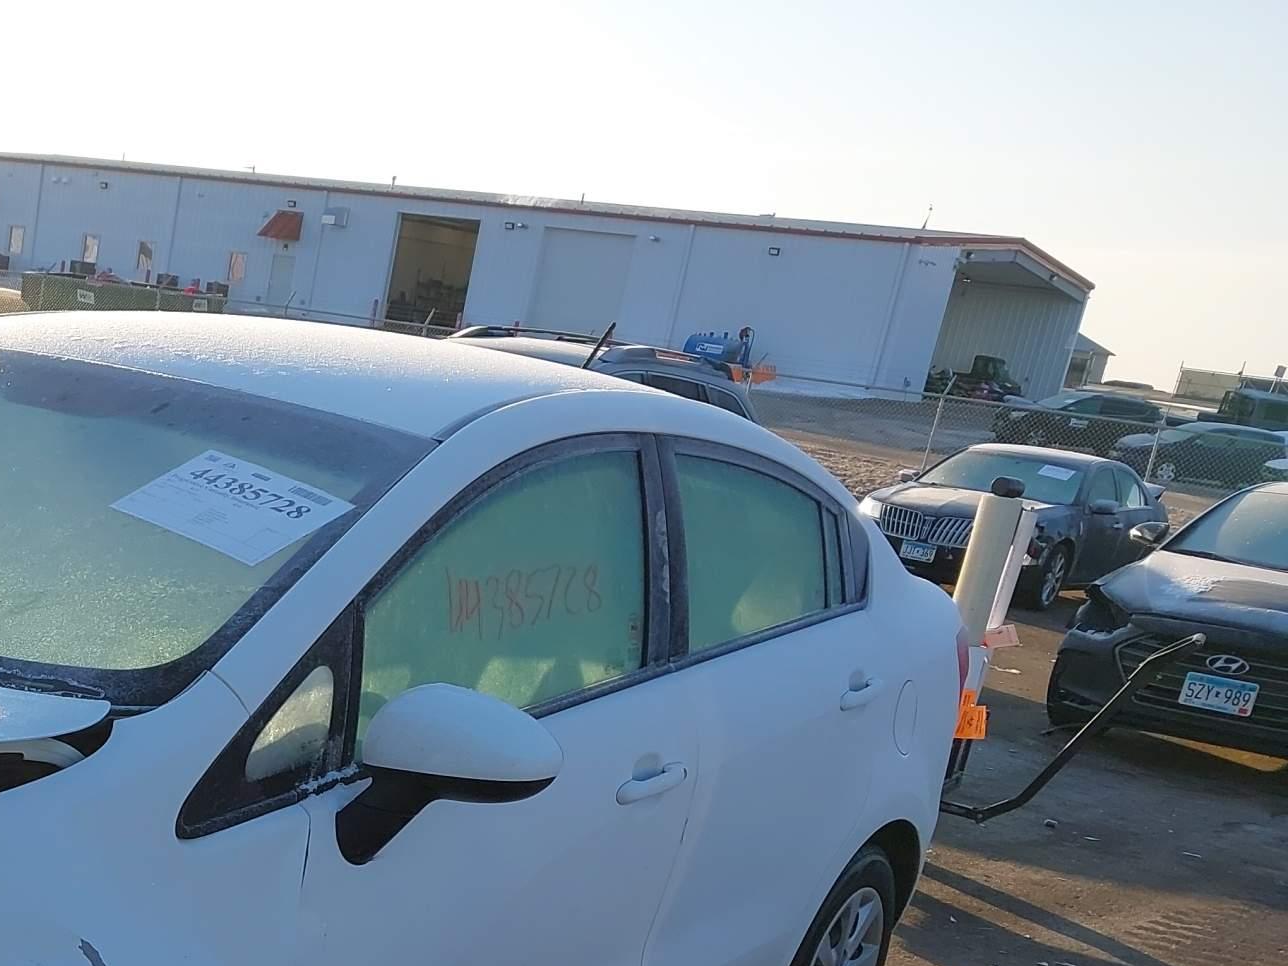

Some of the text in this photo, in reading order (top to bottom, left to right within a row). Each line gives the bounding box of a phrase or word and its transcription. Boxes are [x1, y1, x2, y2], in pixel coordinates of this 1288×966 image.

[189, 467, 312, 519] 44385728
[1185, 681, 1215, 701] SZY
[1224, 688, 1252, 708] 989
